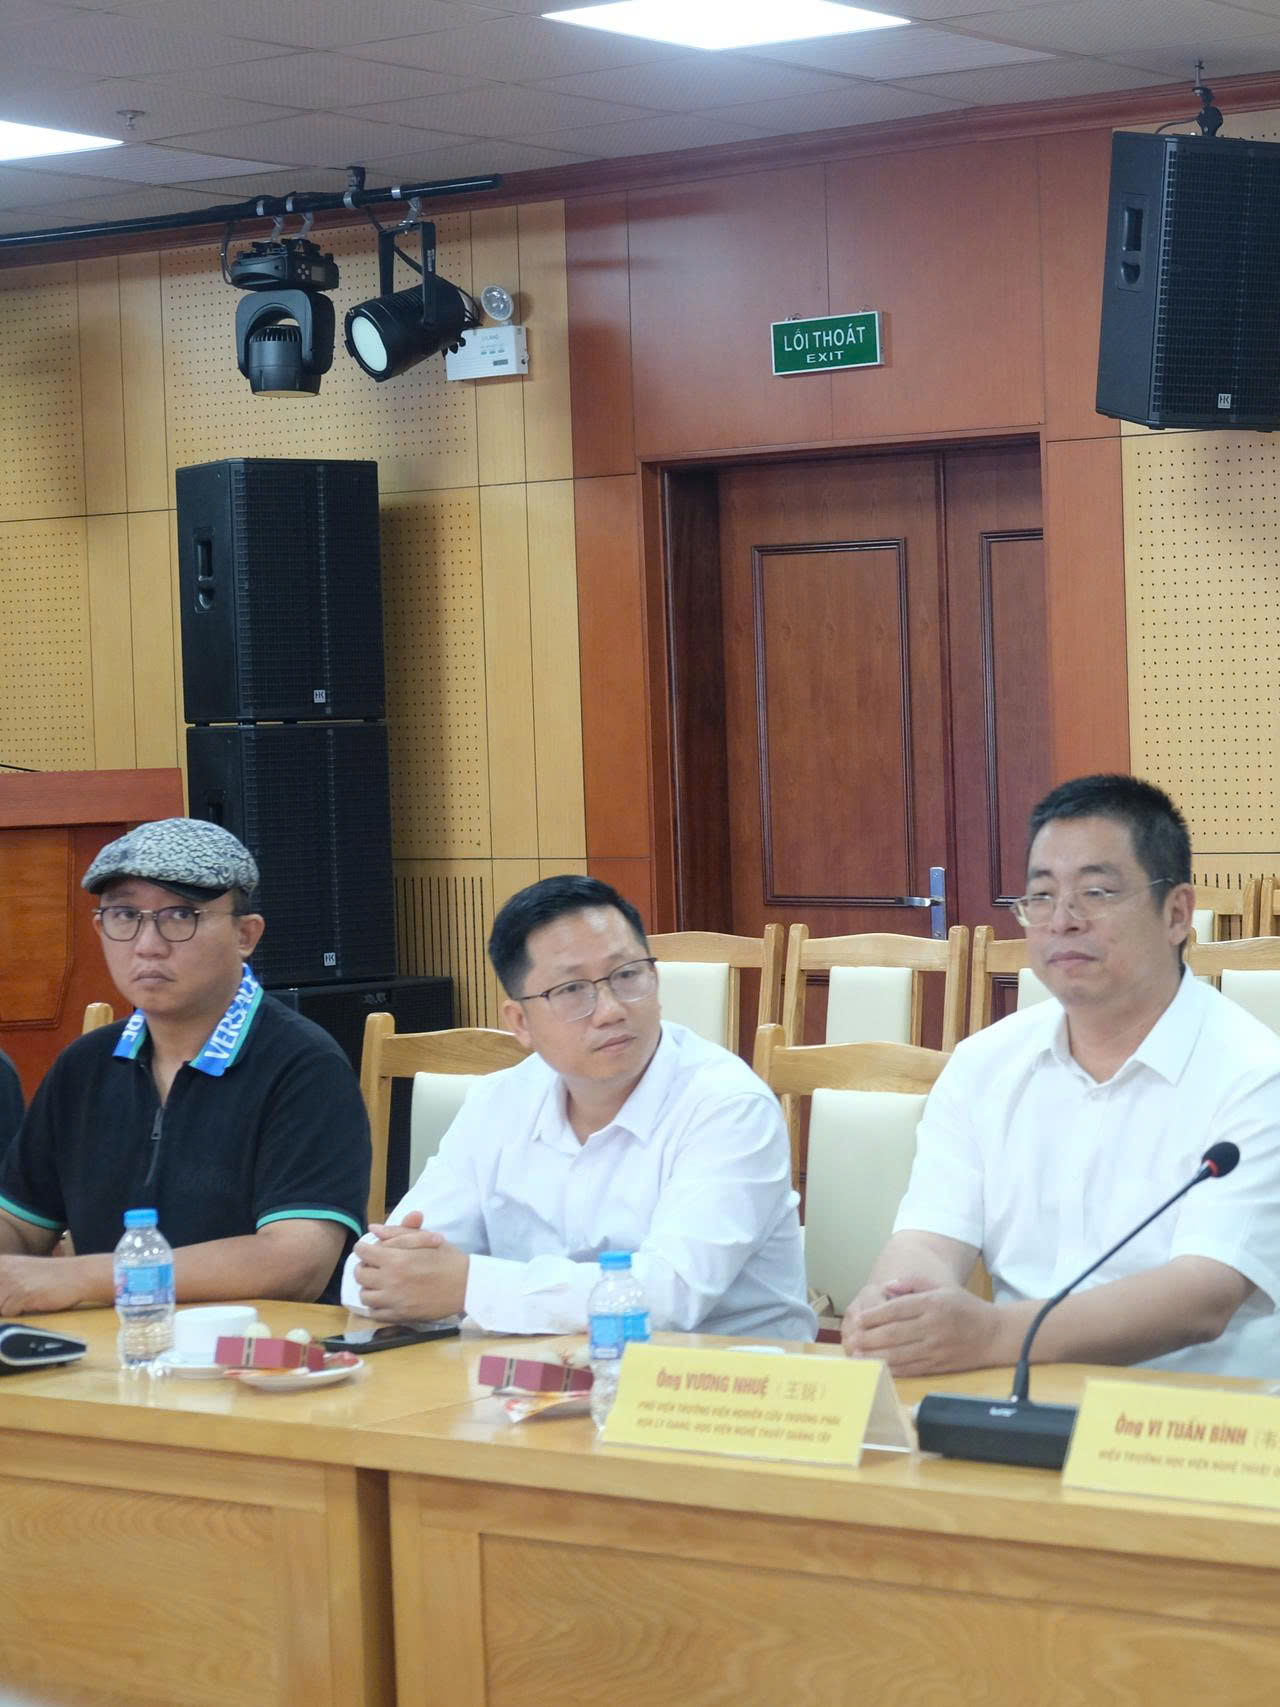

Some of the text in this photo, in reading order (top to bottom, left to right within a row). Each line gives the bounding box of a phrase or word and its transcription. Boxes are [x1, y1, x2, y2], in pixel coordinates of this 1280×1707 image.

[812, 323, 866, 348] THOÁT
[806, 350, 844, 364] EXIT
[1149, 1419, 1163, 1437] VI
